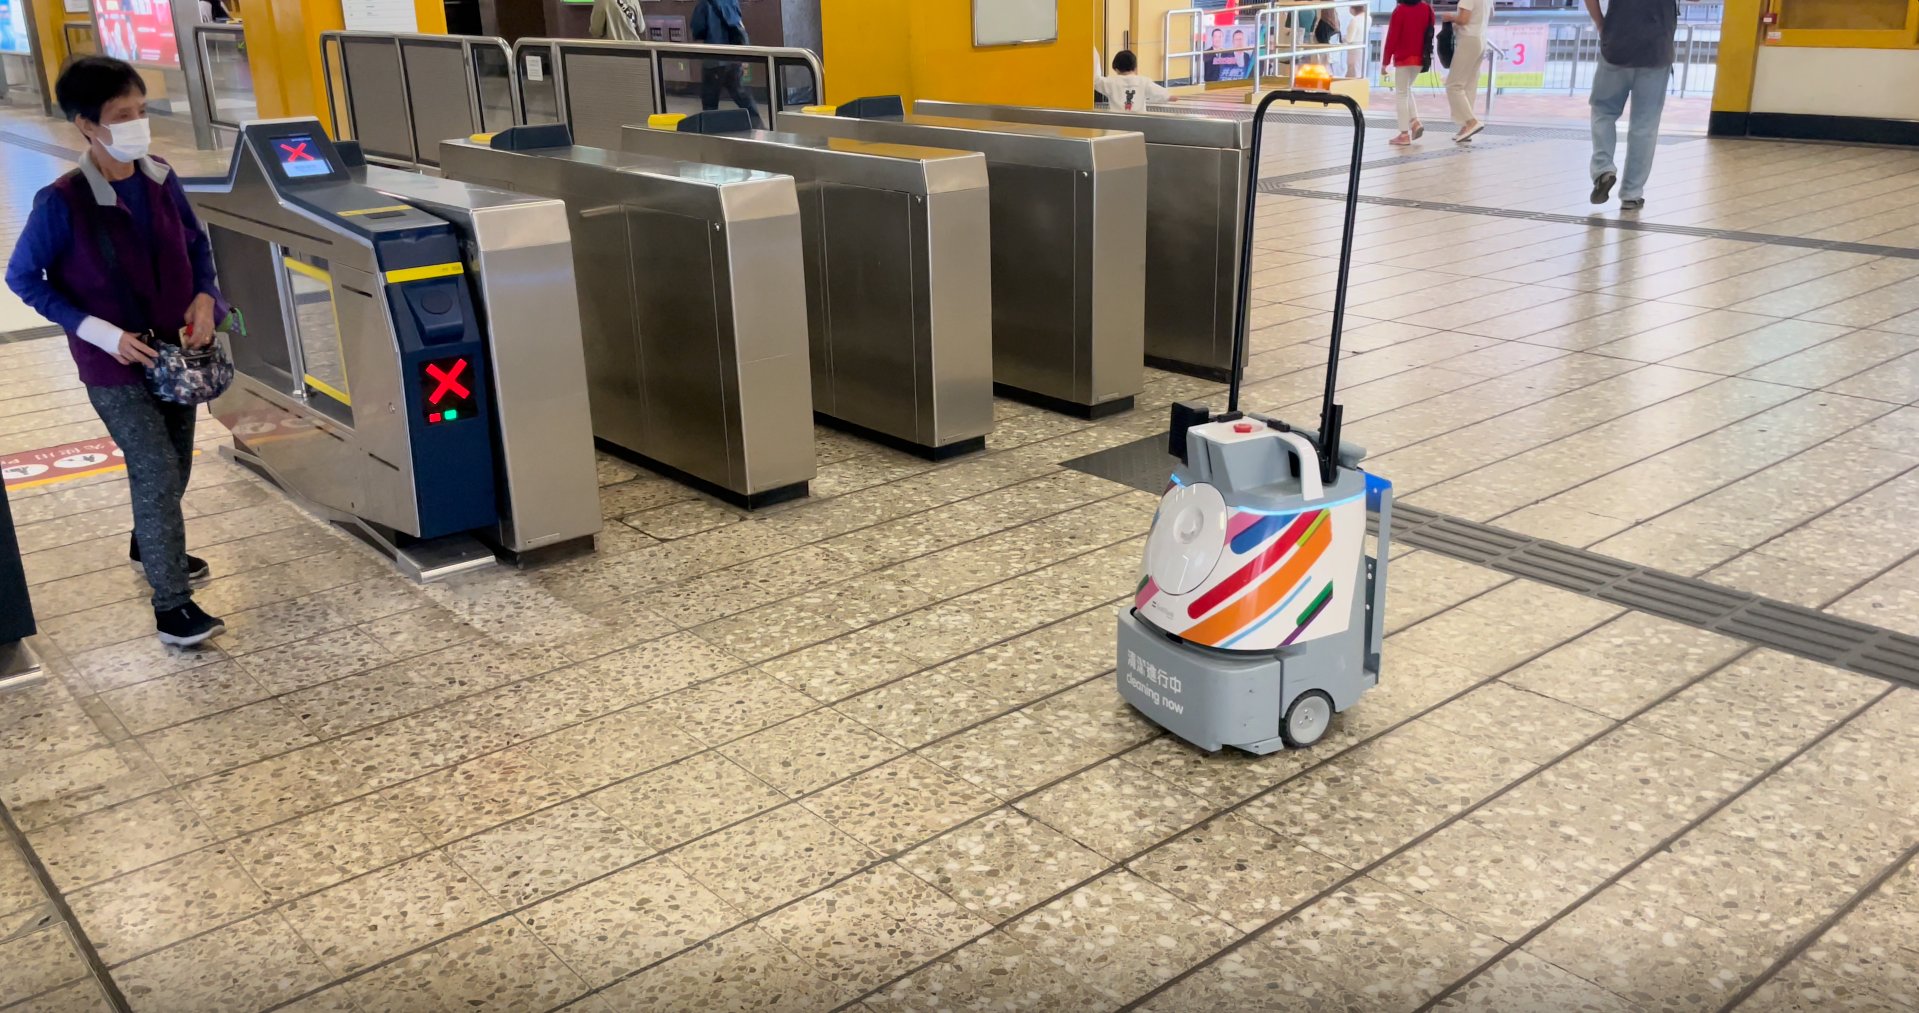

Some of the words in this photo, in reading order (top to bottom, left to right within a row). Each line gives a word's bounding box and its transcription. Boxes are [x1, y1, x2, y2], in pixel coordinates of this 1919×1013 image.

[1512, 42, 1526, 66] 3
[1126, 672, 1160, 706] cleaning
[1162, 696, 1184, 715] now
